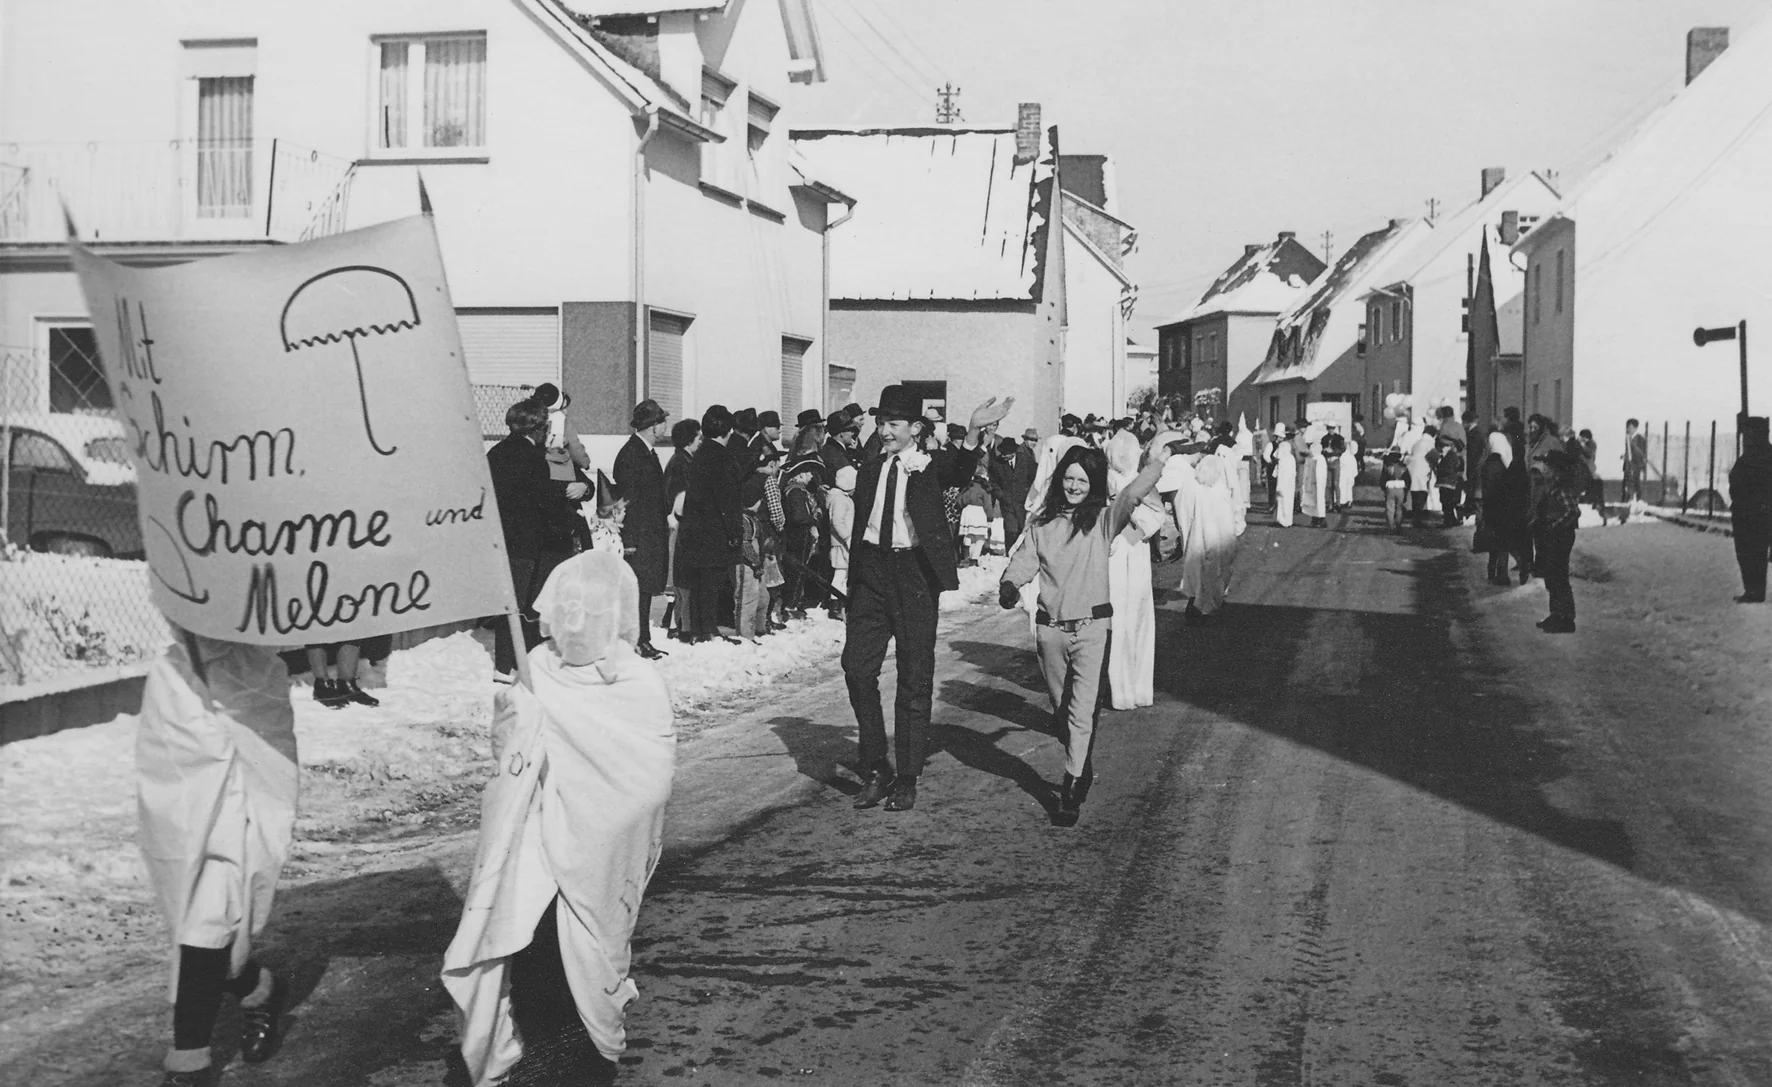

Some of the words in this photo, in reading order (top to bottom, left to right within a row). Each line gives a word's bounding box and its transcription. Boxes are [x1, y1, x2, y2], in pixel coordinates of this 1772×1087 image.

[113, 292, 162, 385] Mit
[176, 489, 392, 557] Charme
[425, 487, 486, 527] und
[235, 560, 431, 635] Melone
